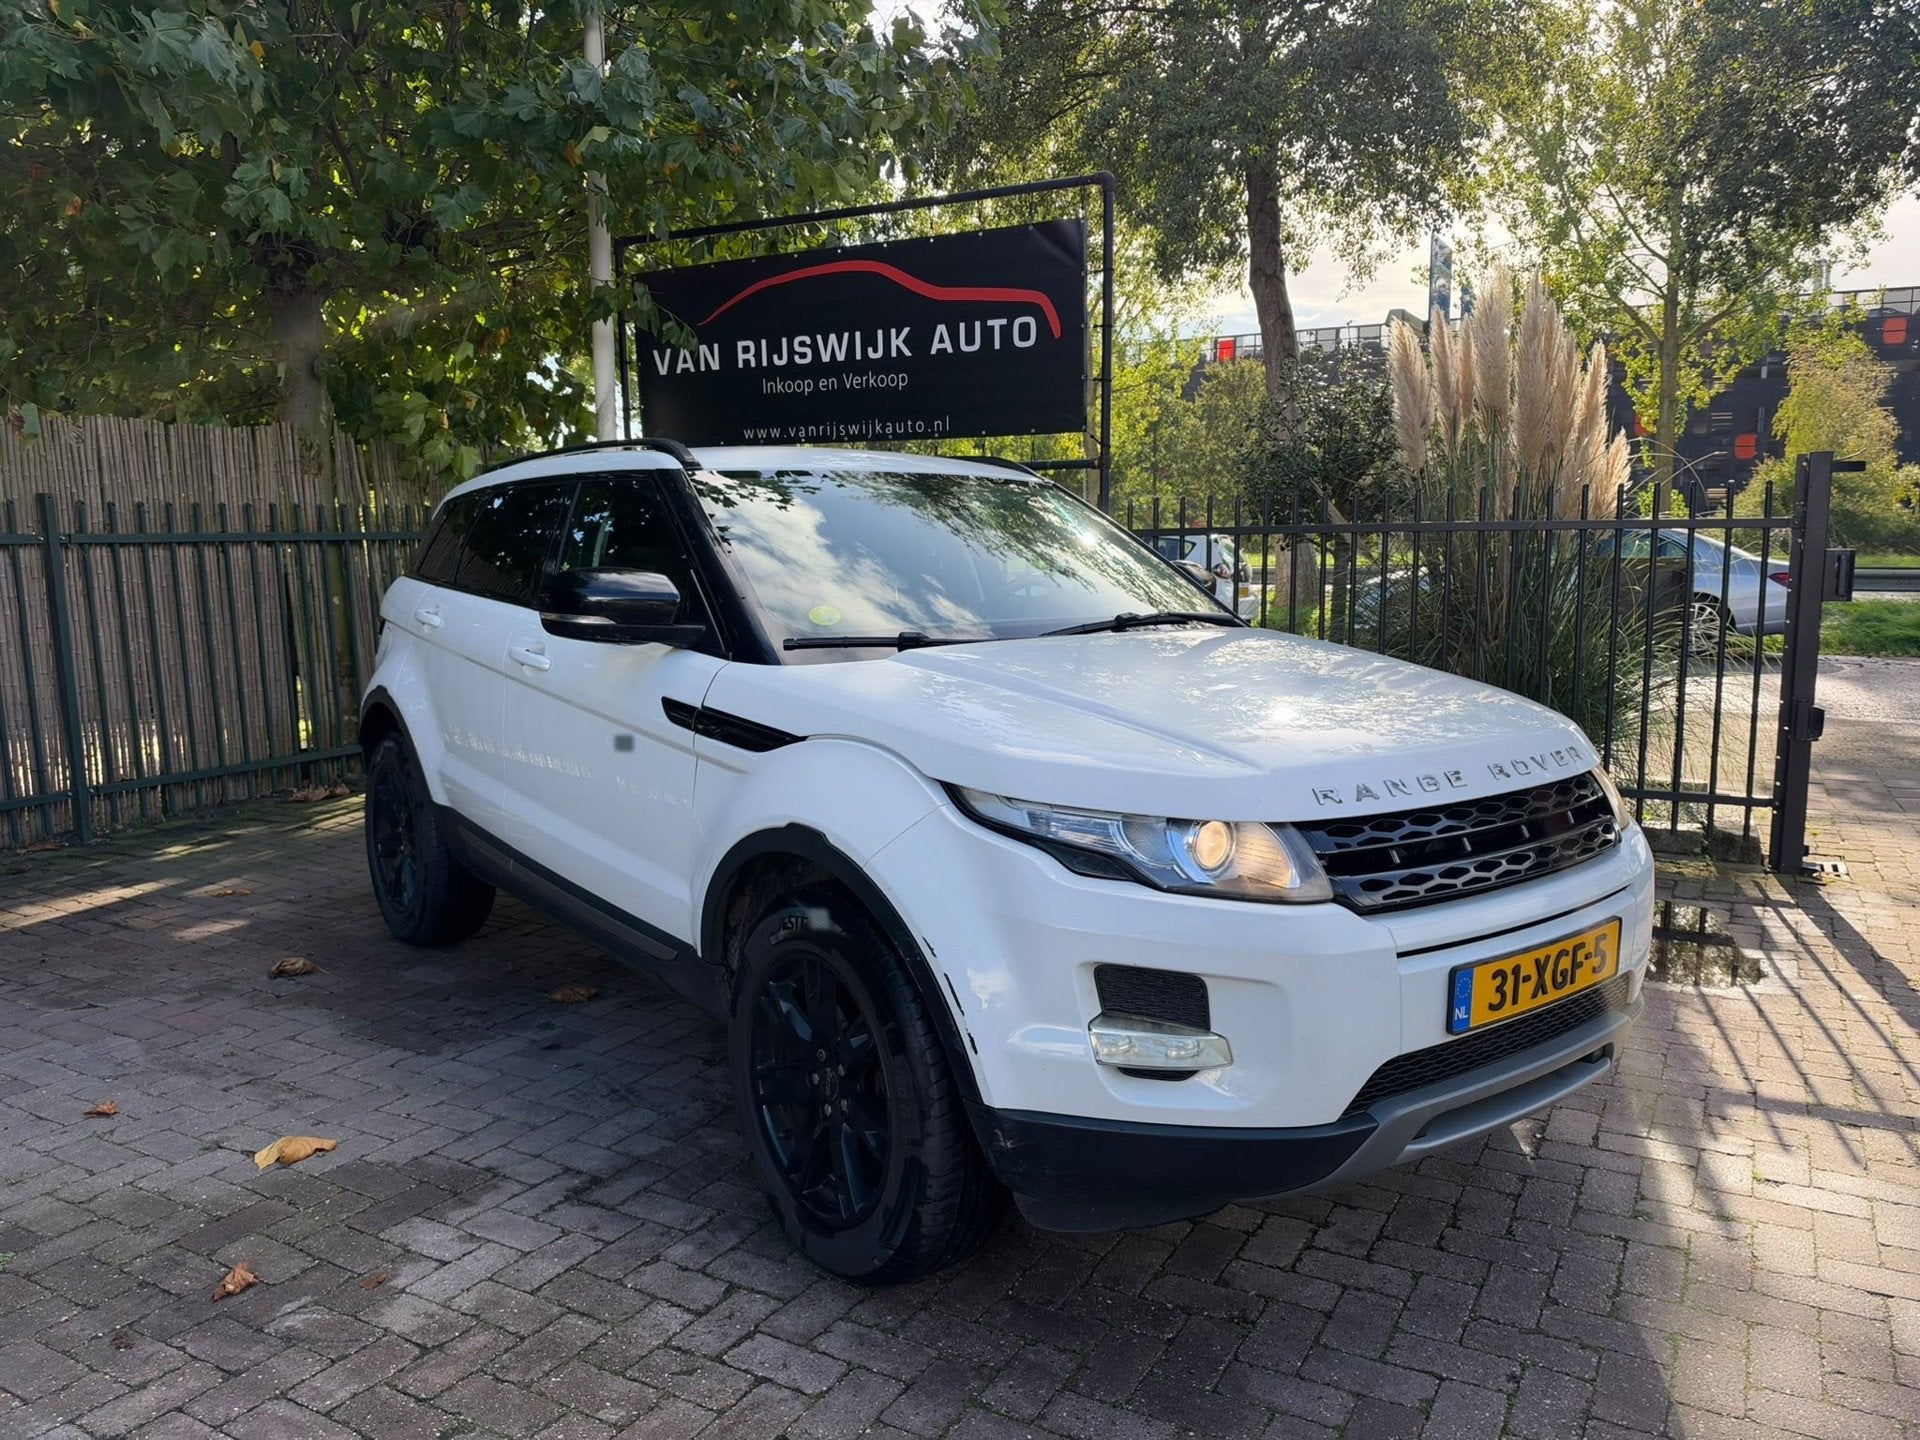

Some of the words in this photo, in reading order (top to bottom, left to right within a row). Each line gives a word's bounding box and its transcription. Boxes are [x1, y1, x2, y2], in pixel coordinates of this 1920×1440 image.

[653, 343, 720, 376] VAN
[738, 326, 912, 369] RIJSWIJK
[930, 316, 1037, 355] AUTO
[763, 376, 813, 395] Inkoop
[819, 378, 837, 391] en
[842, 371, 909, 391] Verkoop
[744, 415, 950, 439] www.vanrijswijkauto.nl
[1312, 770, 1467, 806] RANGE
[1488, 746, 1584, 780] ROVER
[1488, 934, 1608, 1012] 31-XGF-5
[1454, 1007, 1469, 1020] NL
